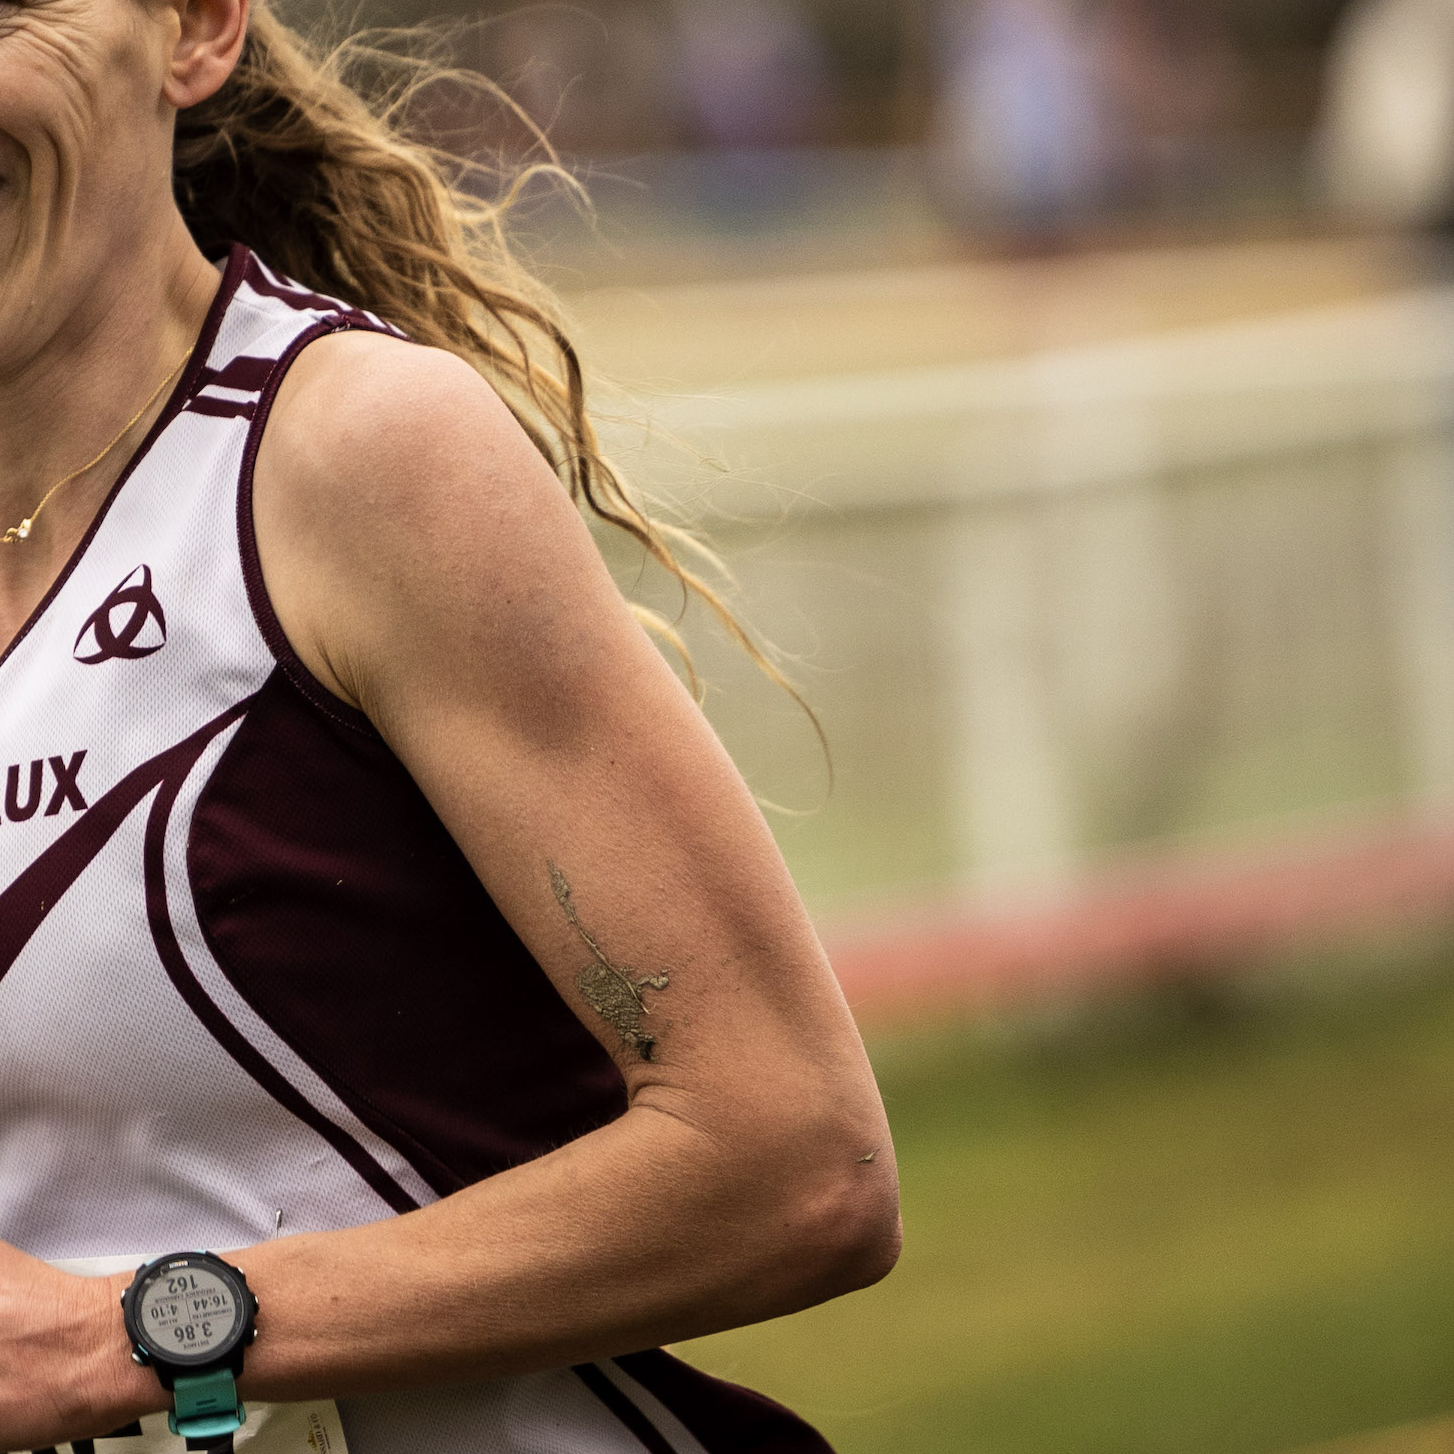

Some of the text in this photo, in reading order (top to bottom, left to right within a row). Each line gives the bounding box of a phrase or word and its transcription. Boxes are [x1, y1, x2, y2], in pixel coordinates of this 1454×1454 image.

[166, 1274, 198, 1294] 162
[151, 1304, 177, 1319] 4:10
[193, 1293, 227, 1311] 16:44
[174, 1321, 213, 1342] 3.86
